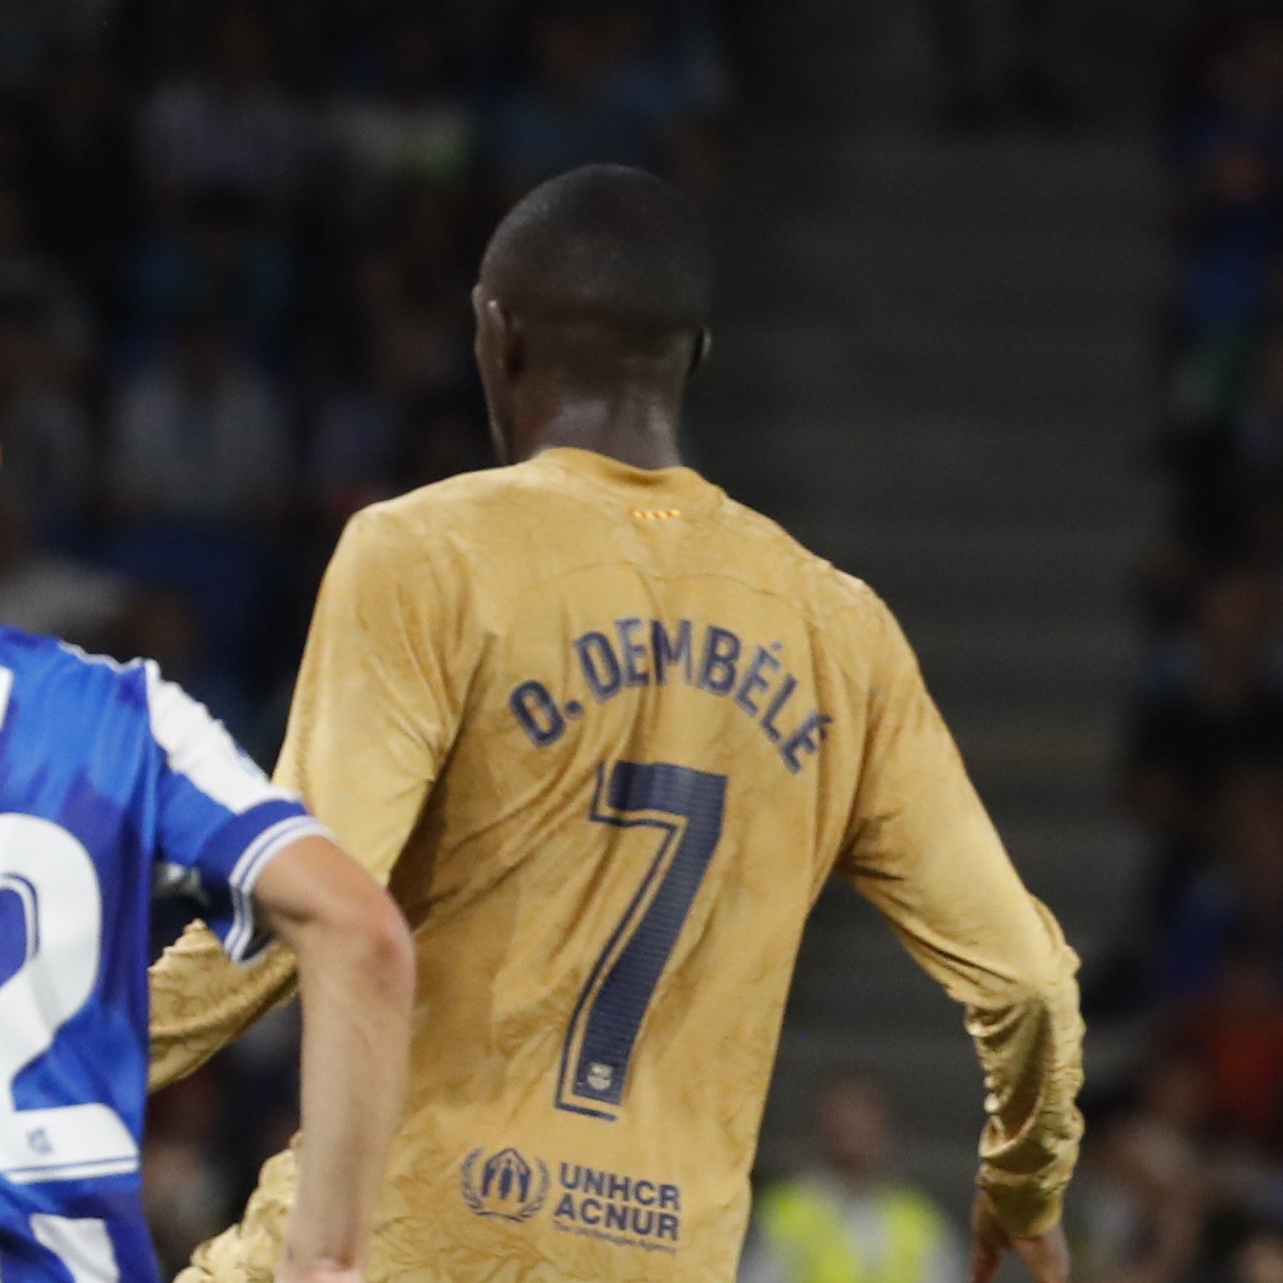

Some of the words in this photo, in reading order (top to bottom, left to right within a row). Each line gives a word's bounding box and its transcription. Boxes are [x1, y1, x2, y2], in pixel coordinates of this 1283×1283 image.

[509, 679, 584, 747] O.
[575, 616, 833, 775] DEMBÉLÉ
[554, 760, 729, 1121] 7
[555, 1193, 680, 1241] ACNUR
[560, 1161, 681, 1211] UNHCR
